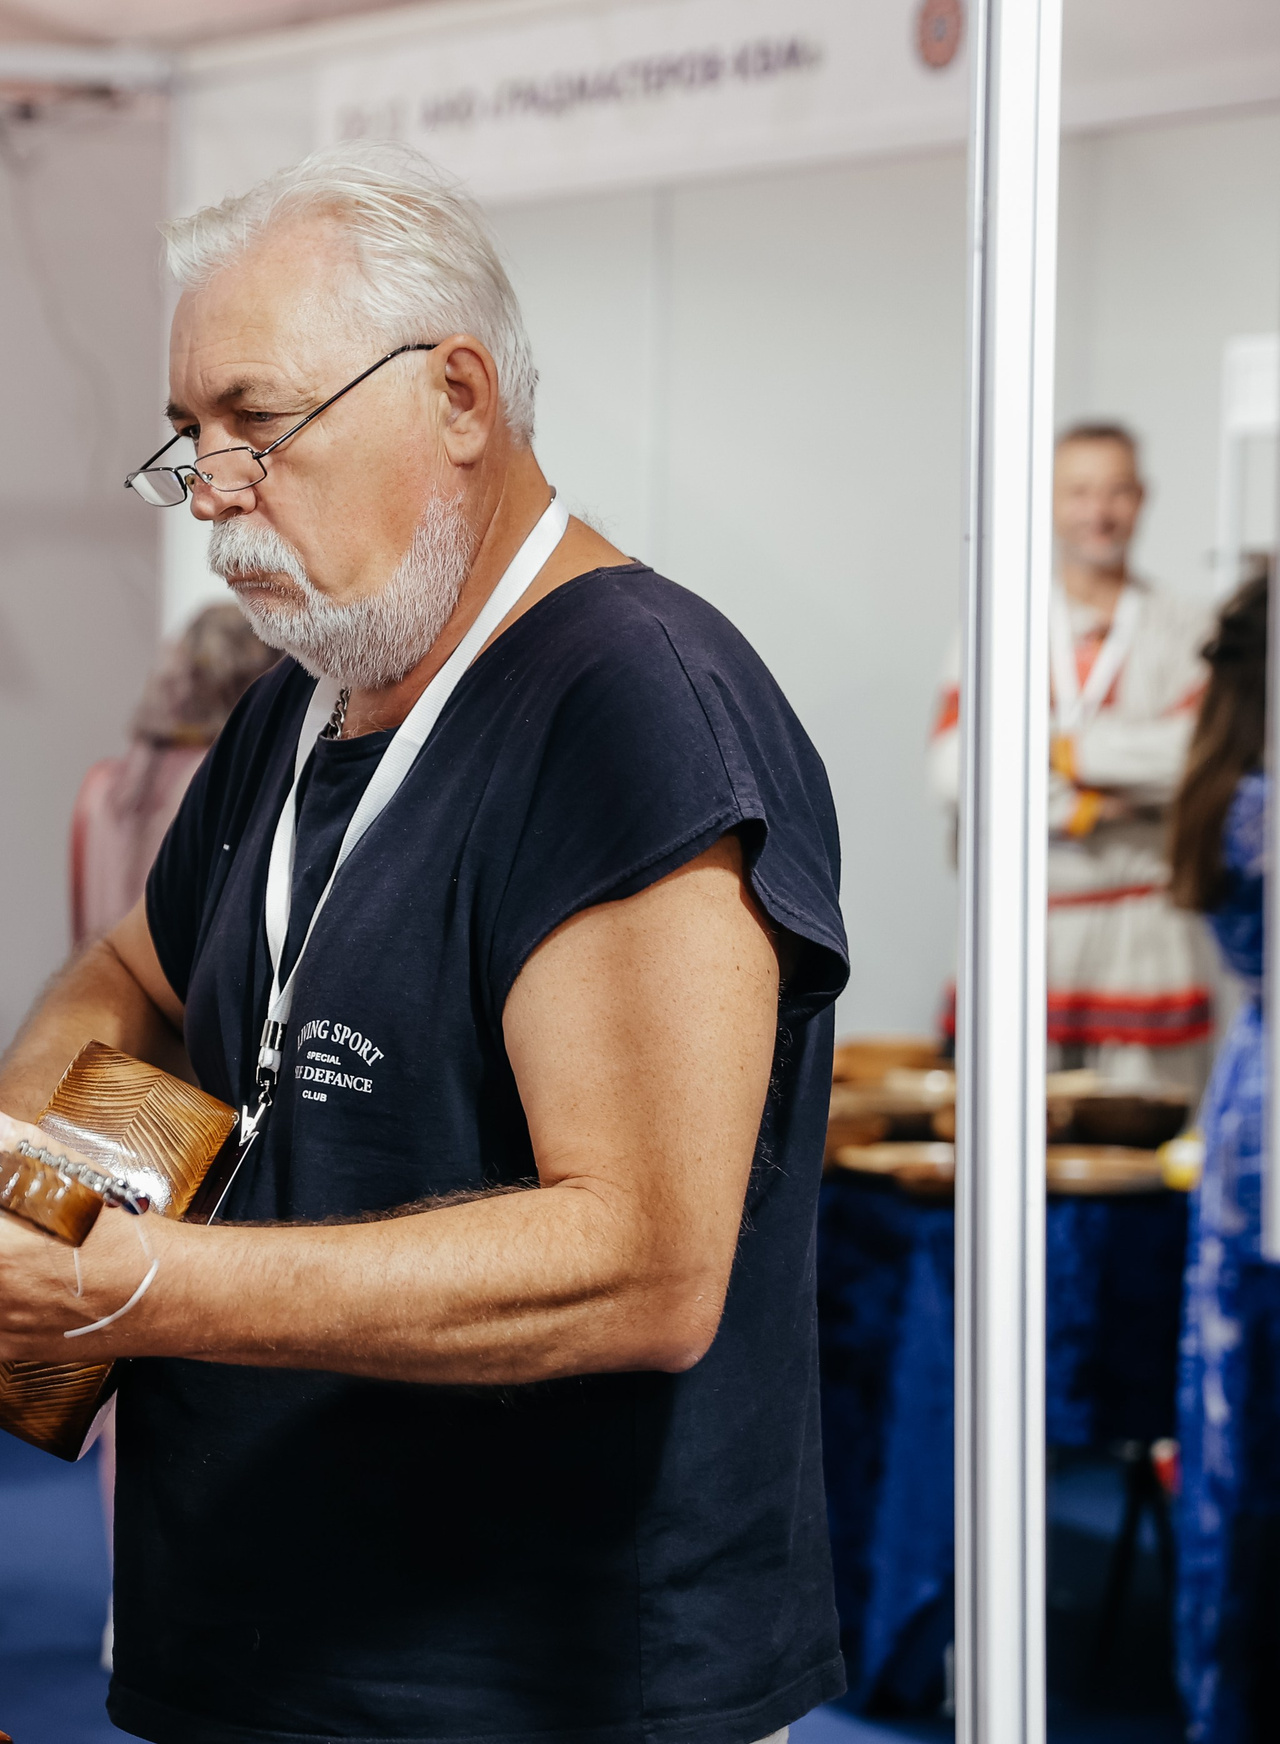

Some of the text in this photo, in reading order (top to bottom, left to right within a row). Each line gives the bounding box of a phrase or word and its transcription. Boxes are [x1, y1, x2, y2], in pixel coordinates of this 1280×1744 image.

[331, 1023, 384, 1066] SPORT
[307, 1051, 341, 1065] SPECIAL
[303, 1066, 373, 1093] DEFANCE
[302, 1090, 327, 1102] CLUB
